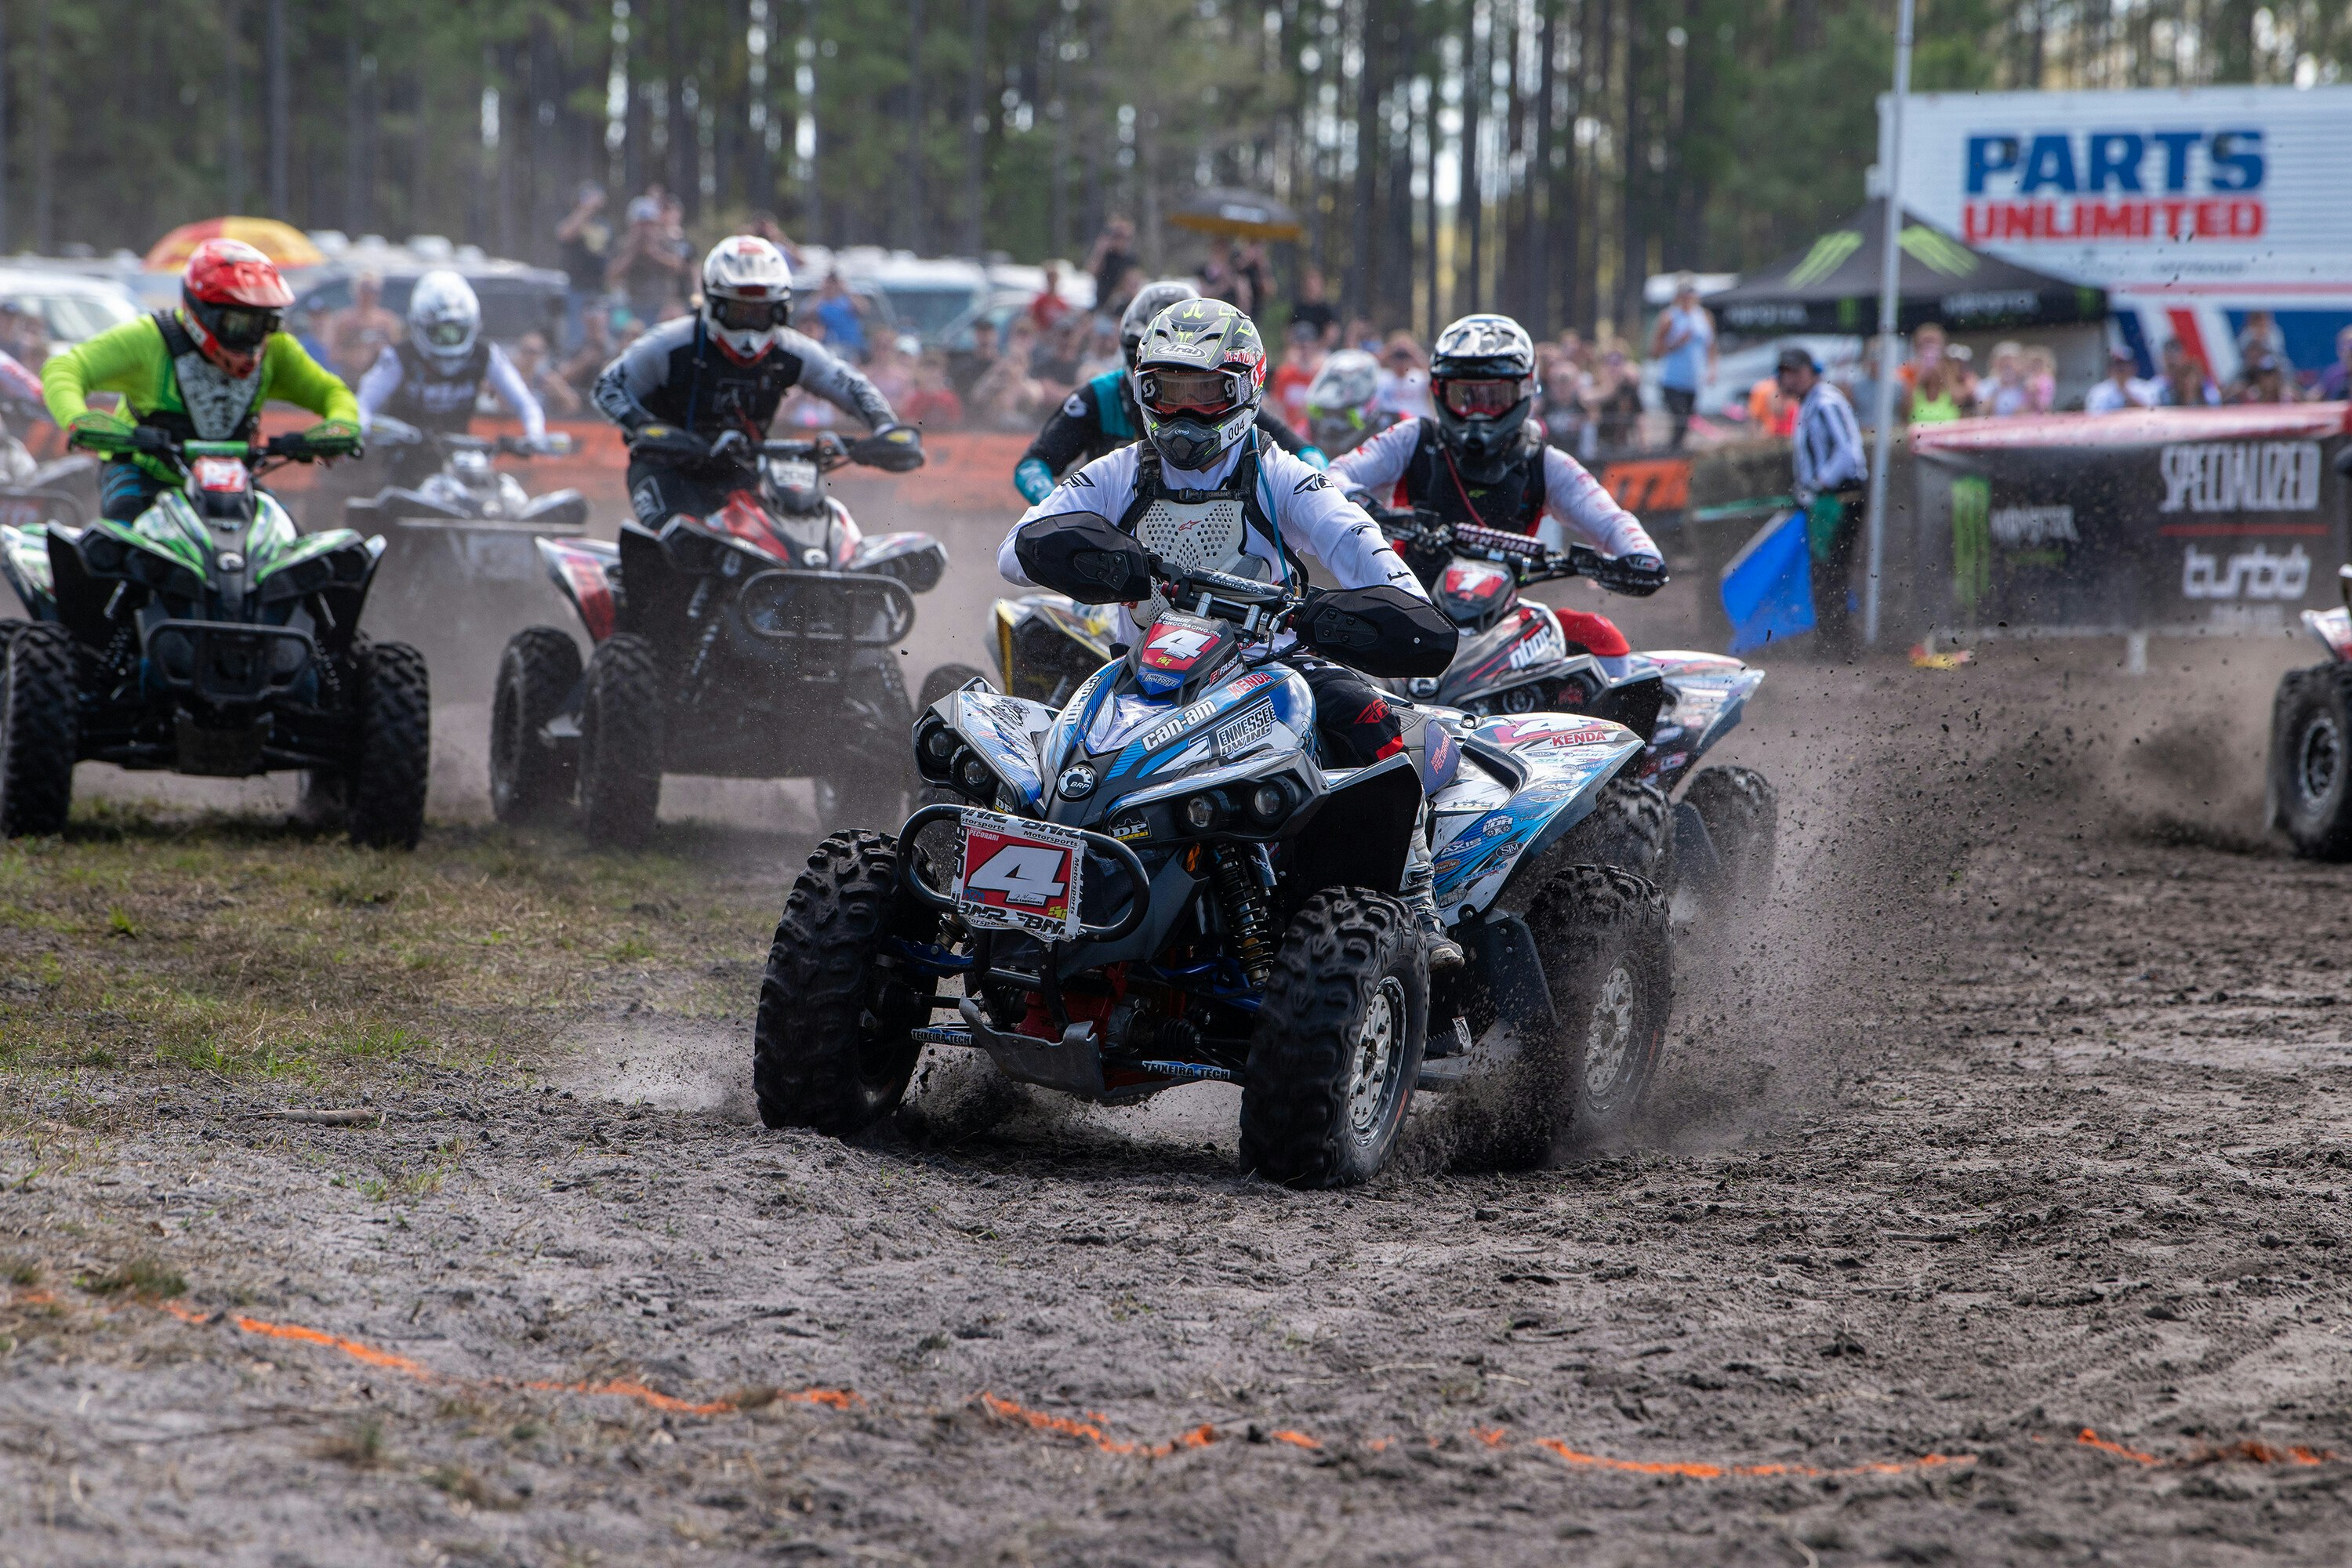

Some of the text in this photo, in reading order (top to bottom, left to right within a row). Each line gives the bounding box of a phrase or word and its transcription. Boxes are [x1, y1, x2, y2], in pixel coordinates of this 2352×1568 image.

[1967, 130, 2265, 194] PARTS
[1965, 200, 2265, 241] UNLIMITED
[1224, 350, 1255, 365] KENDA
[1228, 419, 1245, 441] 004
[2159, 441, 2322, 513] SPECIALIZED
[1147, 629, 1212, 659] 4
[1218, 654, 1239, 676] FASST
[1228, 672, 1276, 700] KENDA
[1142, 699, 1217, 752] can-am
[1552, 731, 1606, 747] KENDA
[968, 829, 1000, 842] PECORARI
[1023, 829, 1079, 848] Motorsports
[1112, 823, 1148, 838] DP
[1441, 837, 1482, 855] AXIS
[1501, 841, 1520, 855] SIM
[967, 844, 1066, 906] 4
[1069, 857, 1080, 915] Motorsports
[911, 1029, 971, 1044] TEIXEIRA TECH
[1143, 1062, 1230, 1080] TEIXEIRA TECH
